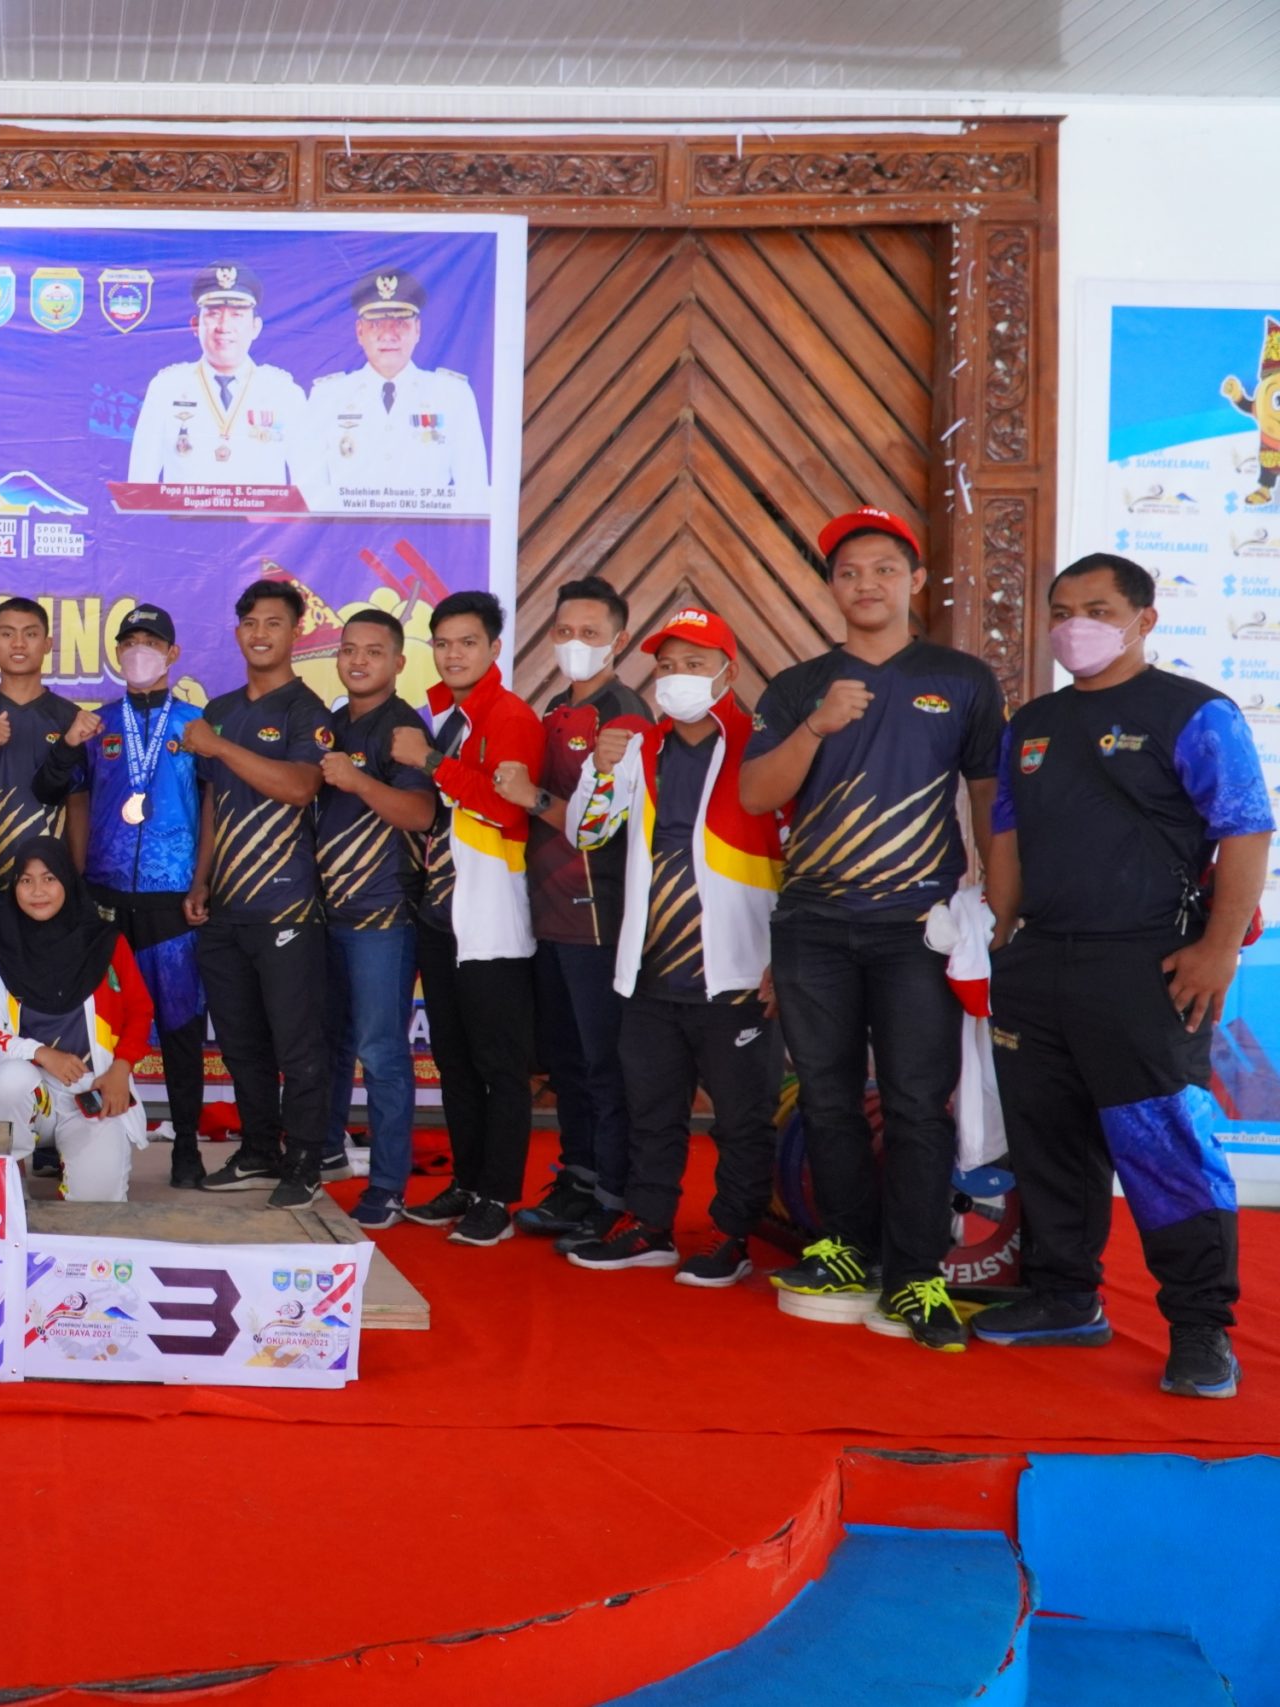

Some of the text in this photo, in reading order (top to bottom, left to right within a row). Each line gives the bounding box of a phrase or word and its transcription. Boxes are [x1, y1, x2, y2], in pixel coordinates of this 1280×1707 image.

[1135, 459, 1210, 470] SUMSELBABEL
[183, 486, 194, 495] Ali
[235, 486, 244, 495] B.
[246, 487, 289, 497] Commerce
[184, 497, 264, 508] Bupati OKU Selatan
[343, 499, 452, 509] Wakil Bupati OKU Selatan
[37, 536, 82, 544] TOURISM
[1135, 531, 1162, 539] BANK
[36, 546, 82, 554] CULTURE
[1134, 541, 1209, 553] SUMSELBABEL
[1241, 576, 1269, 585] BANK
[1240, 659, 1267, 668] BANK
[146, 1266, 243, 1356] 3
[49, 1328, 67, 1336] OKU
[69, 1329, 90, 1337] RAYA
[92, 1330, 111, 1338] 2021
[266, 1337, 328, 1347] OKU RAYA 2021
